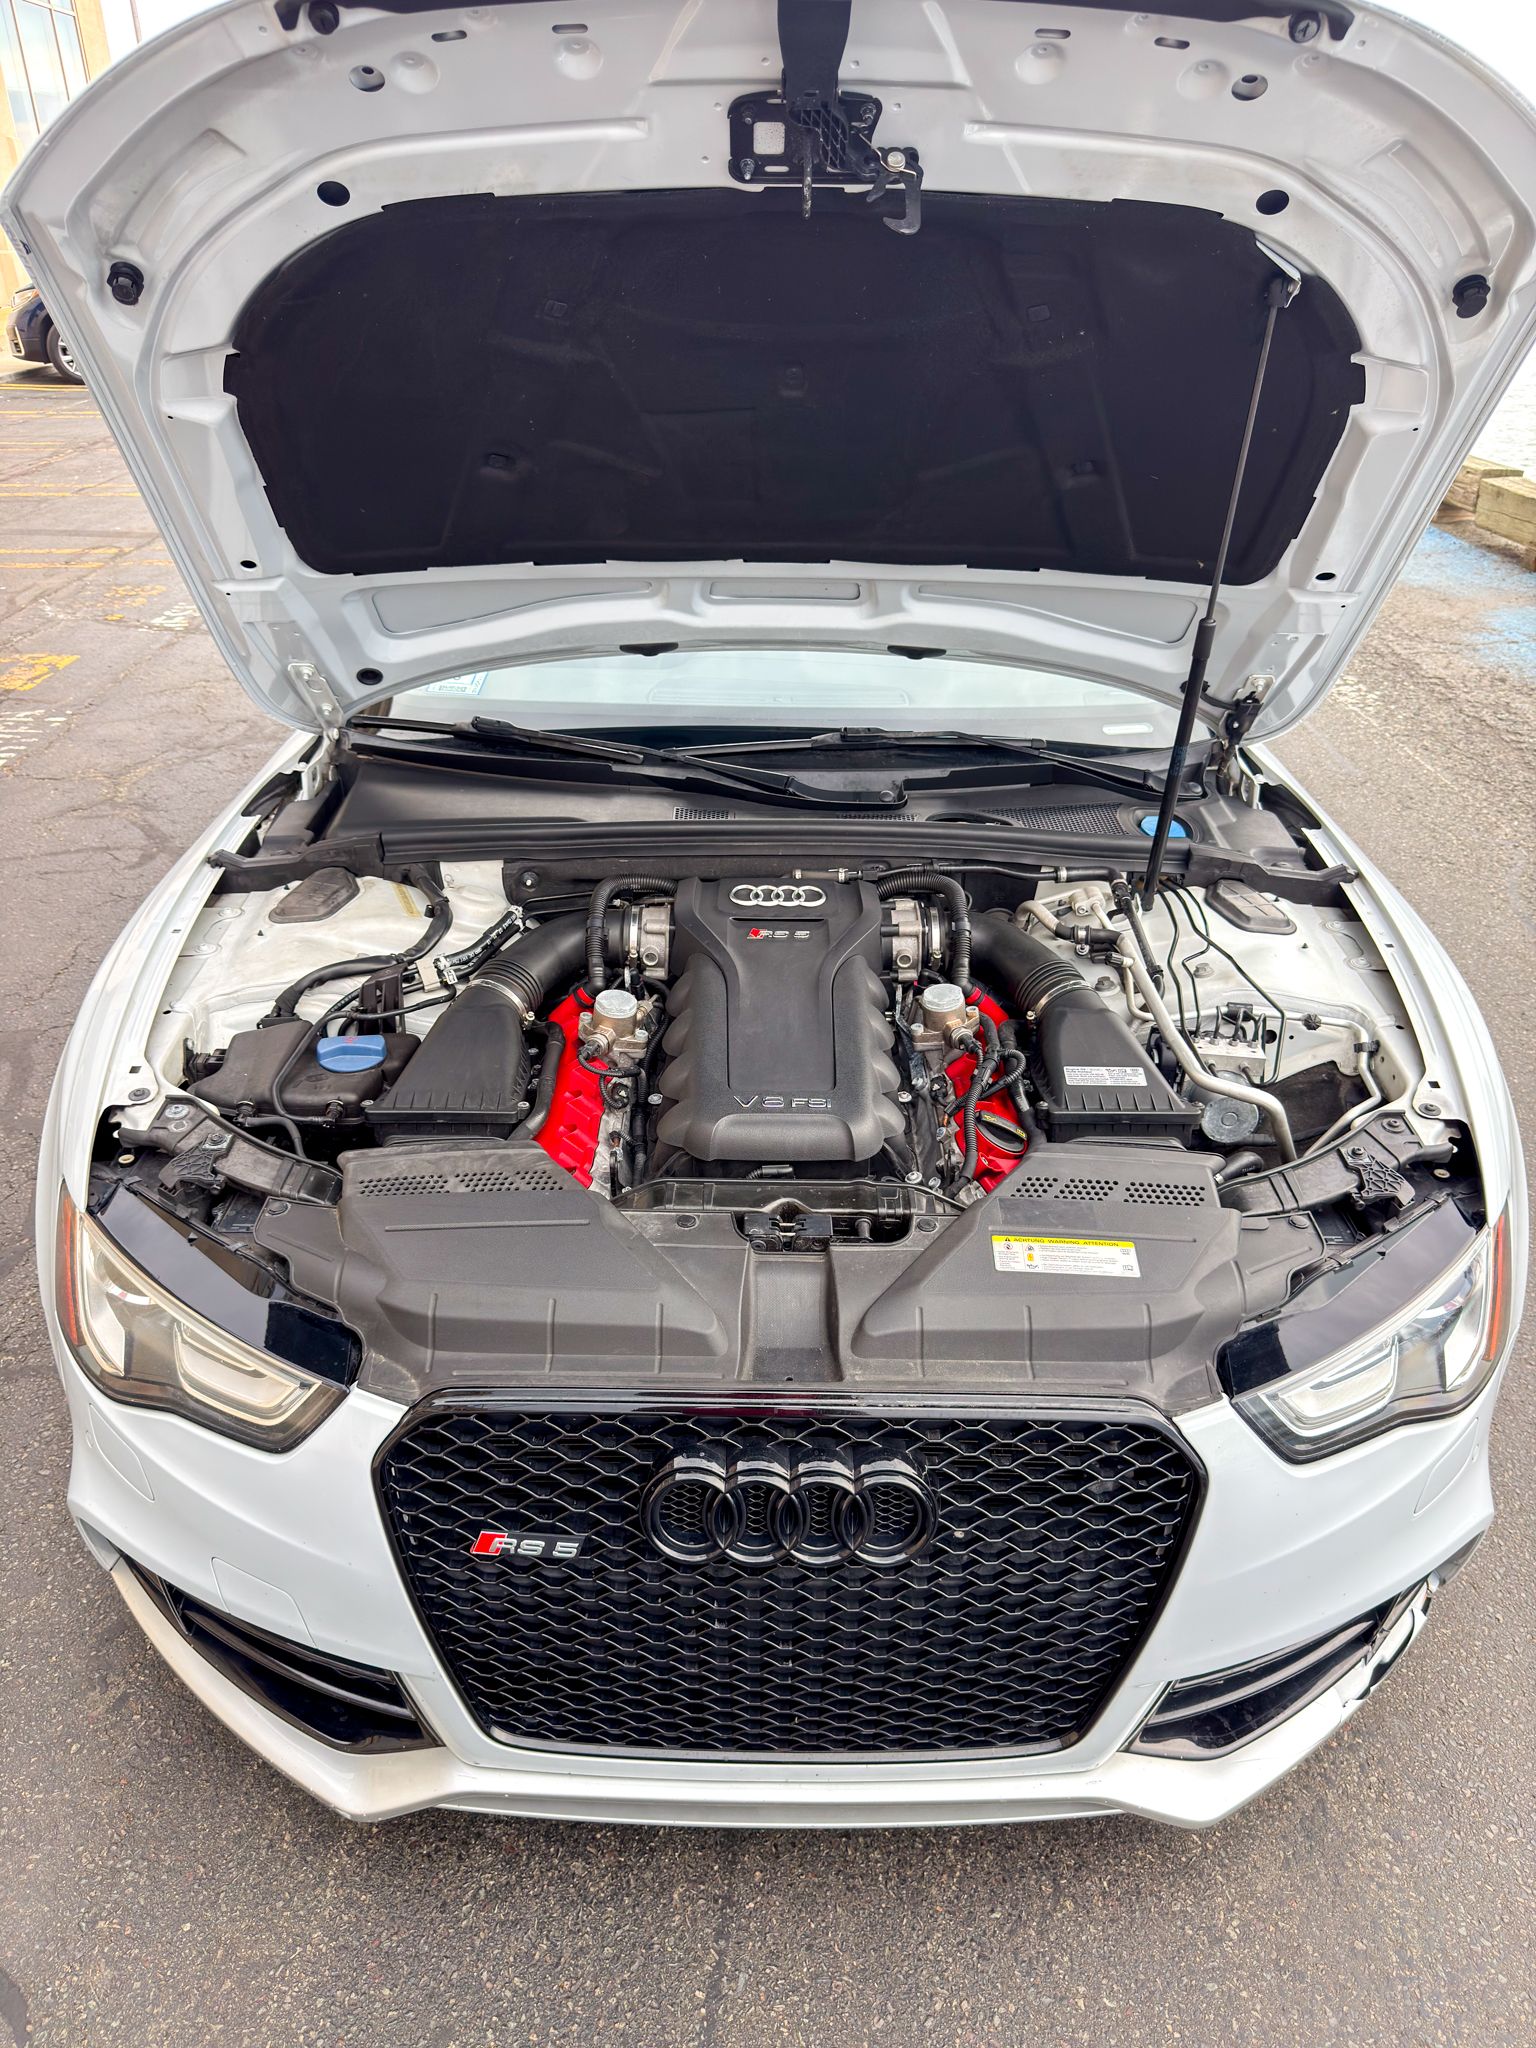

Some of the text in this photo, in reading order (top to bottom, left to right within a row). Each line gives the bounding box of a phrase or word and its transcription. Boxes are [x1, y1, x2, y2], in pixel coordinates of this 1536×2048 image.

[733, 1095, 785, 1108] V8
[489, 1537, 580, 1559] RS 5
